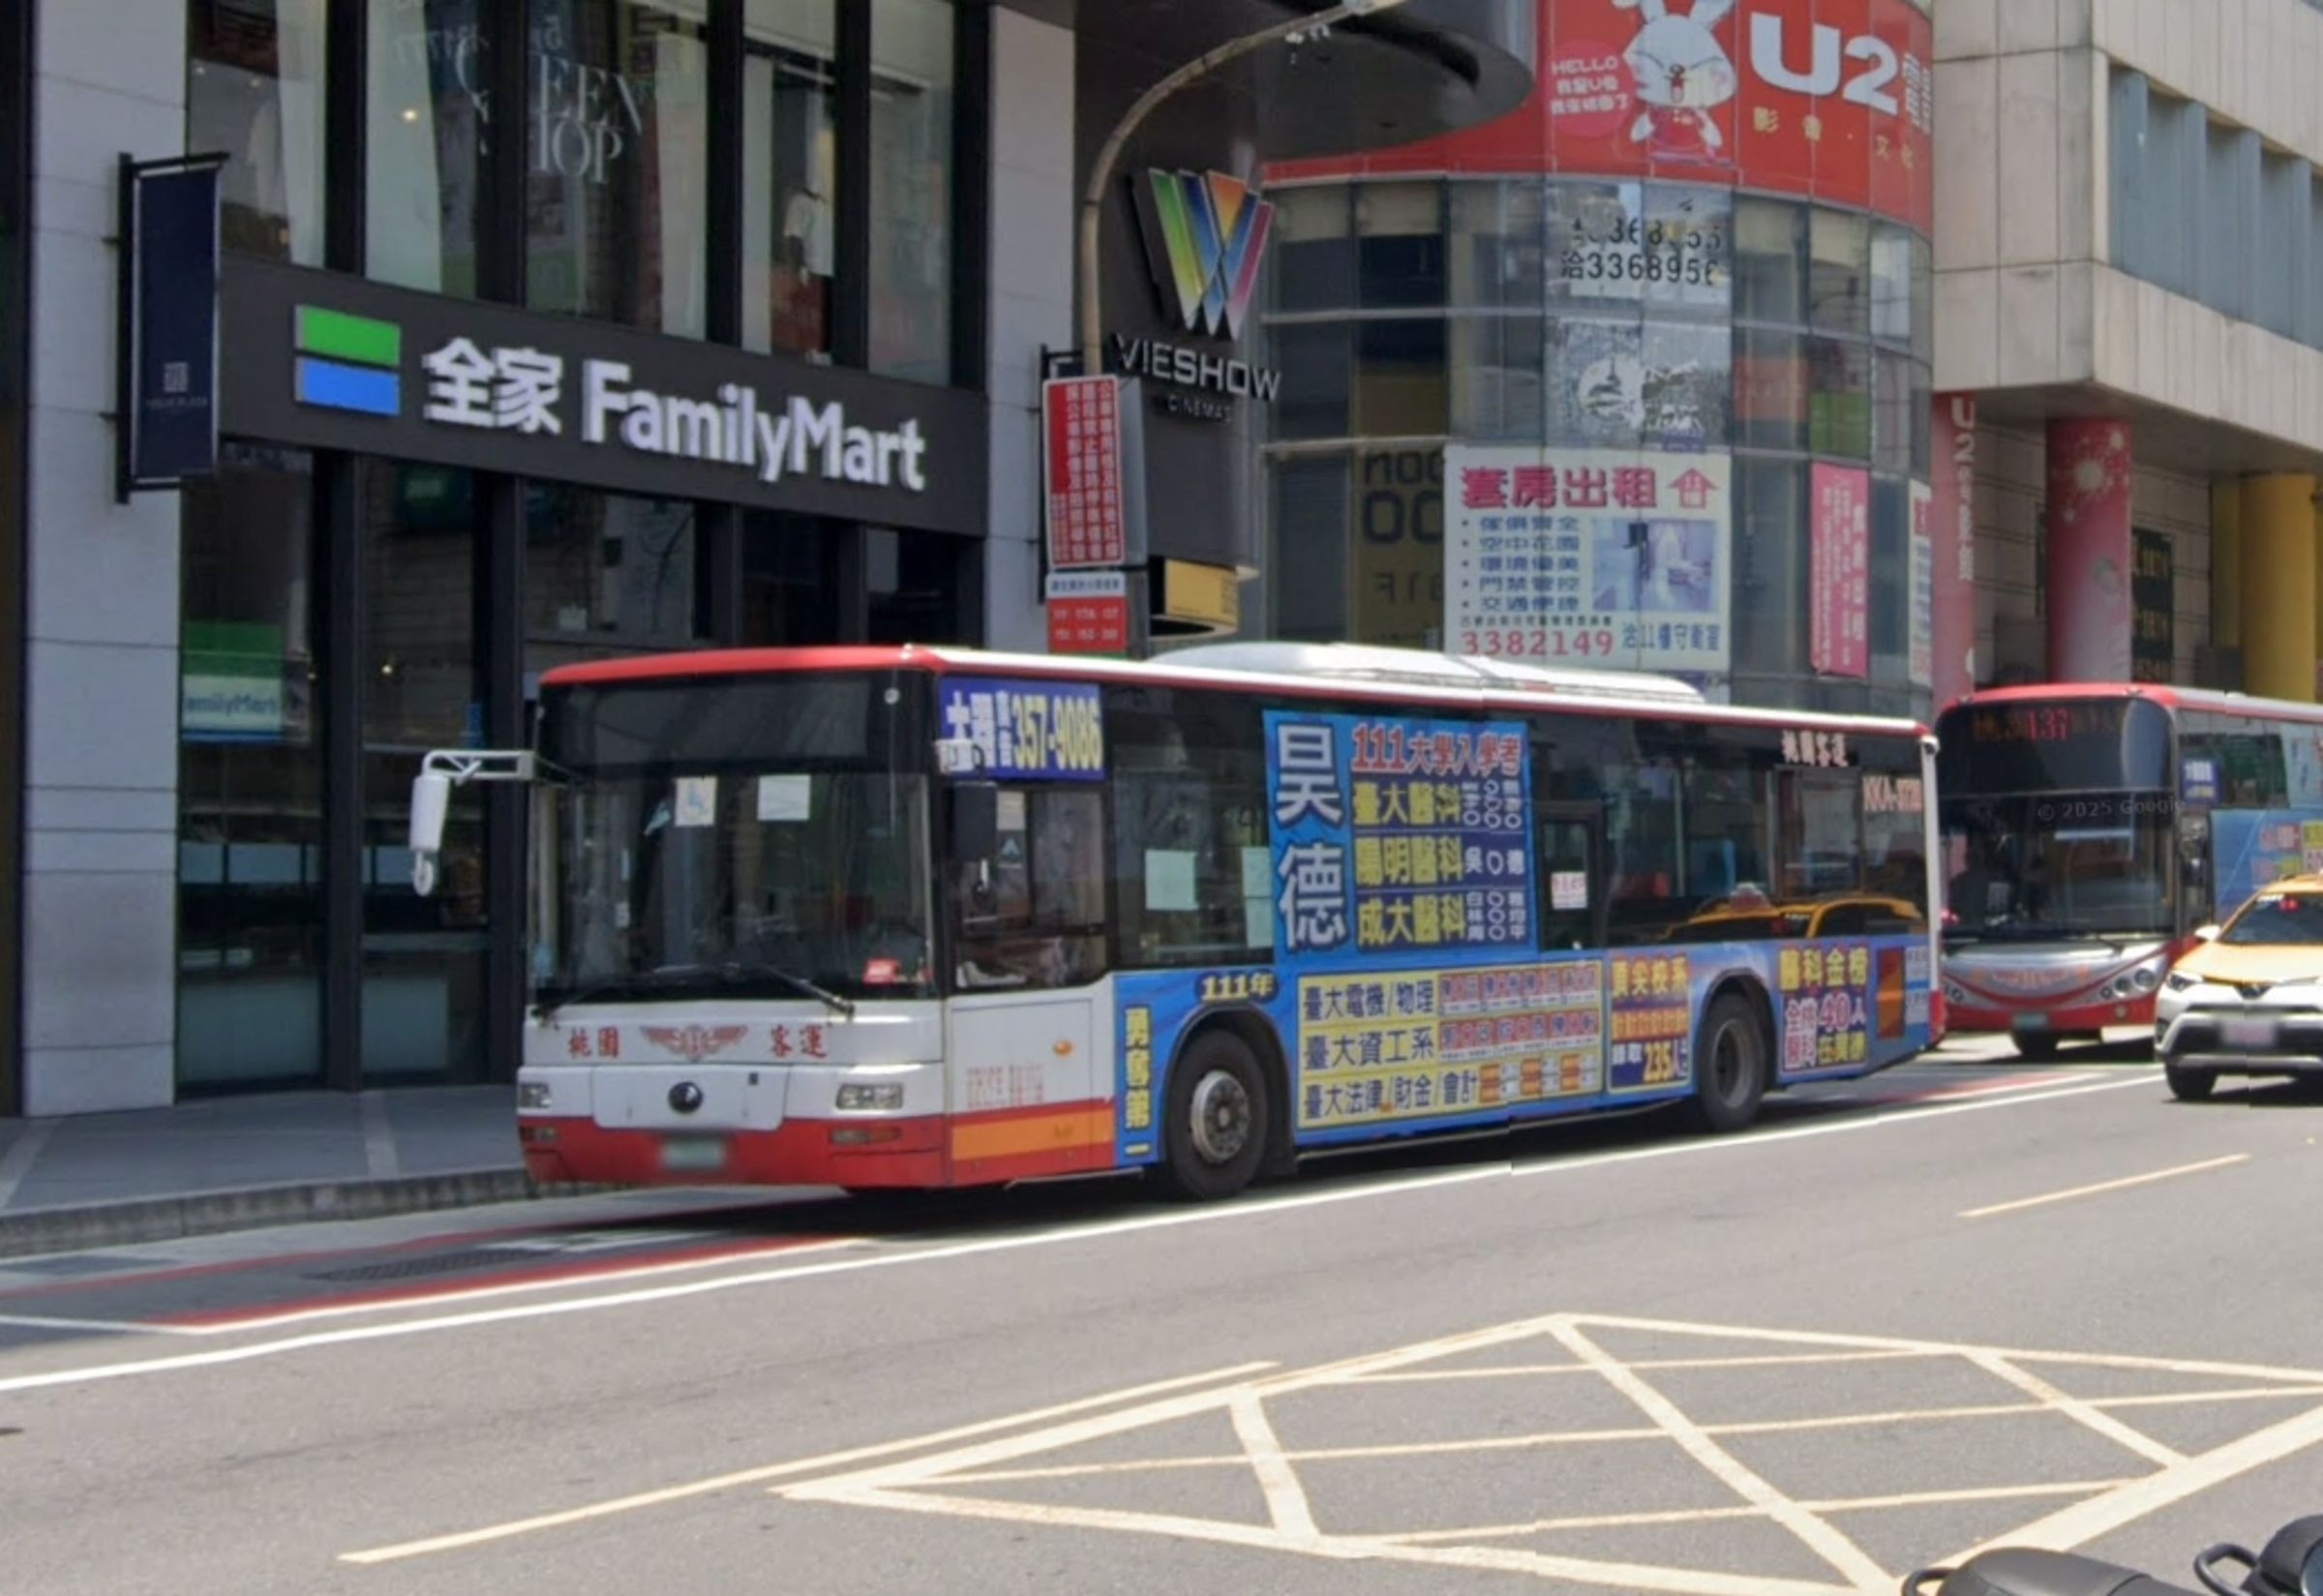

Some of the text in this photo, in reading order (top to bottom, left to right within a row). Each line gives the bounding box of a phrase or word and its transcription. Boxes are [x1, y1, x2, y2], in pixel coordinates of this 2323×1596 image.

[1552, 55, 1618, 75] HELLO
[1750, 11, 1898, 116] U2
[1115, 333, 1282, 402] VIESHOW
[421, 336, 926, 491] 全家 FamilyMart
[1461, 466, 1658, 509] 套房出租
[1461, 630, 1614, 657] 3382149
[1011, 693, 1104, 770] 357-9086
[1357, 893, 1467, 946] 成大醫科
[1200, 972, 1275, 1002] 111年
[1303, 979, 1435, 1021] 臺大電機/物理
[568, 1023, 828, 1060] 桃園 客運
[1303, 1026, 1435, 1070] 臺大資工系
[1303, 1069, 1478, 1121] 臺大法律/財金/會計
